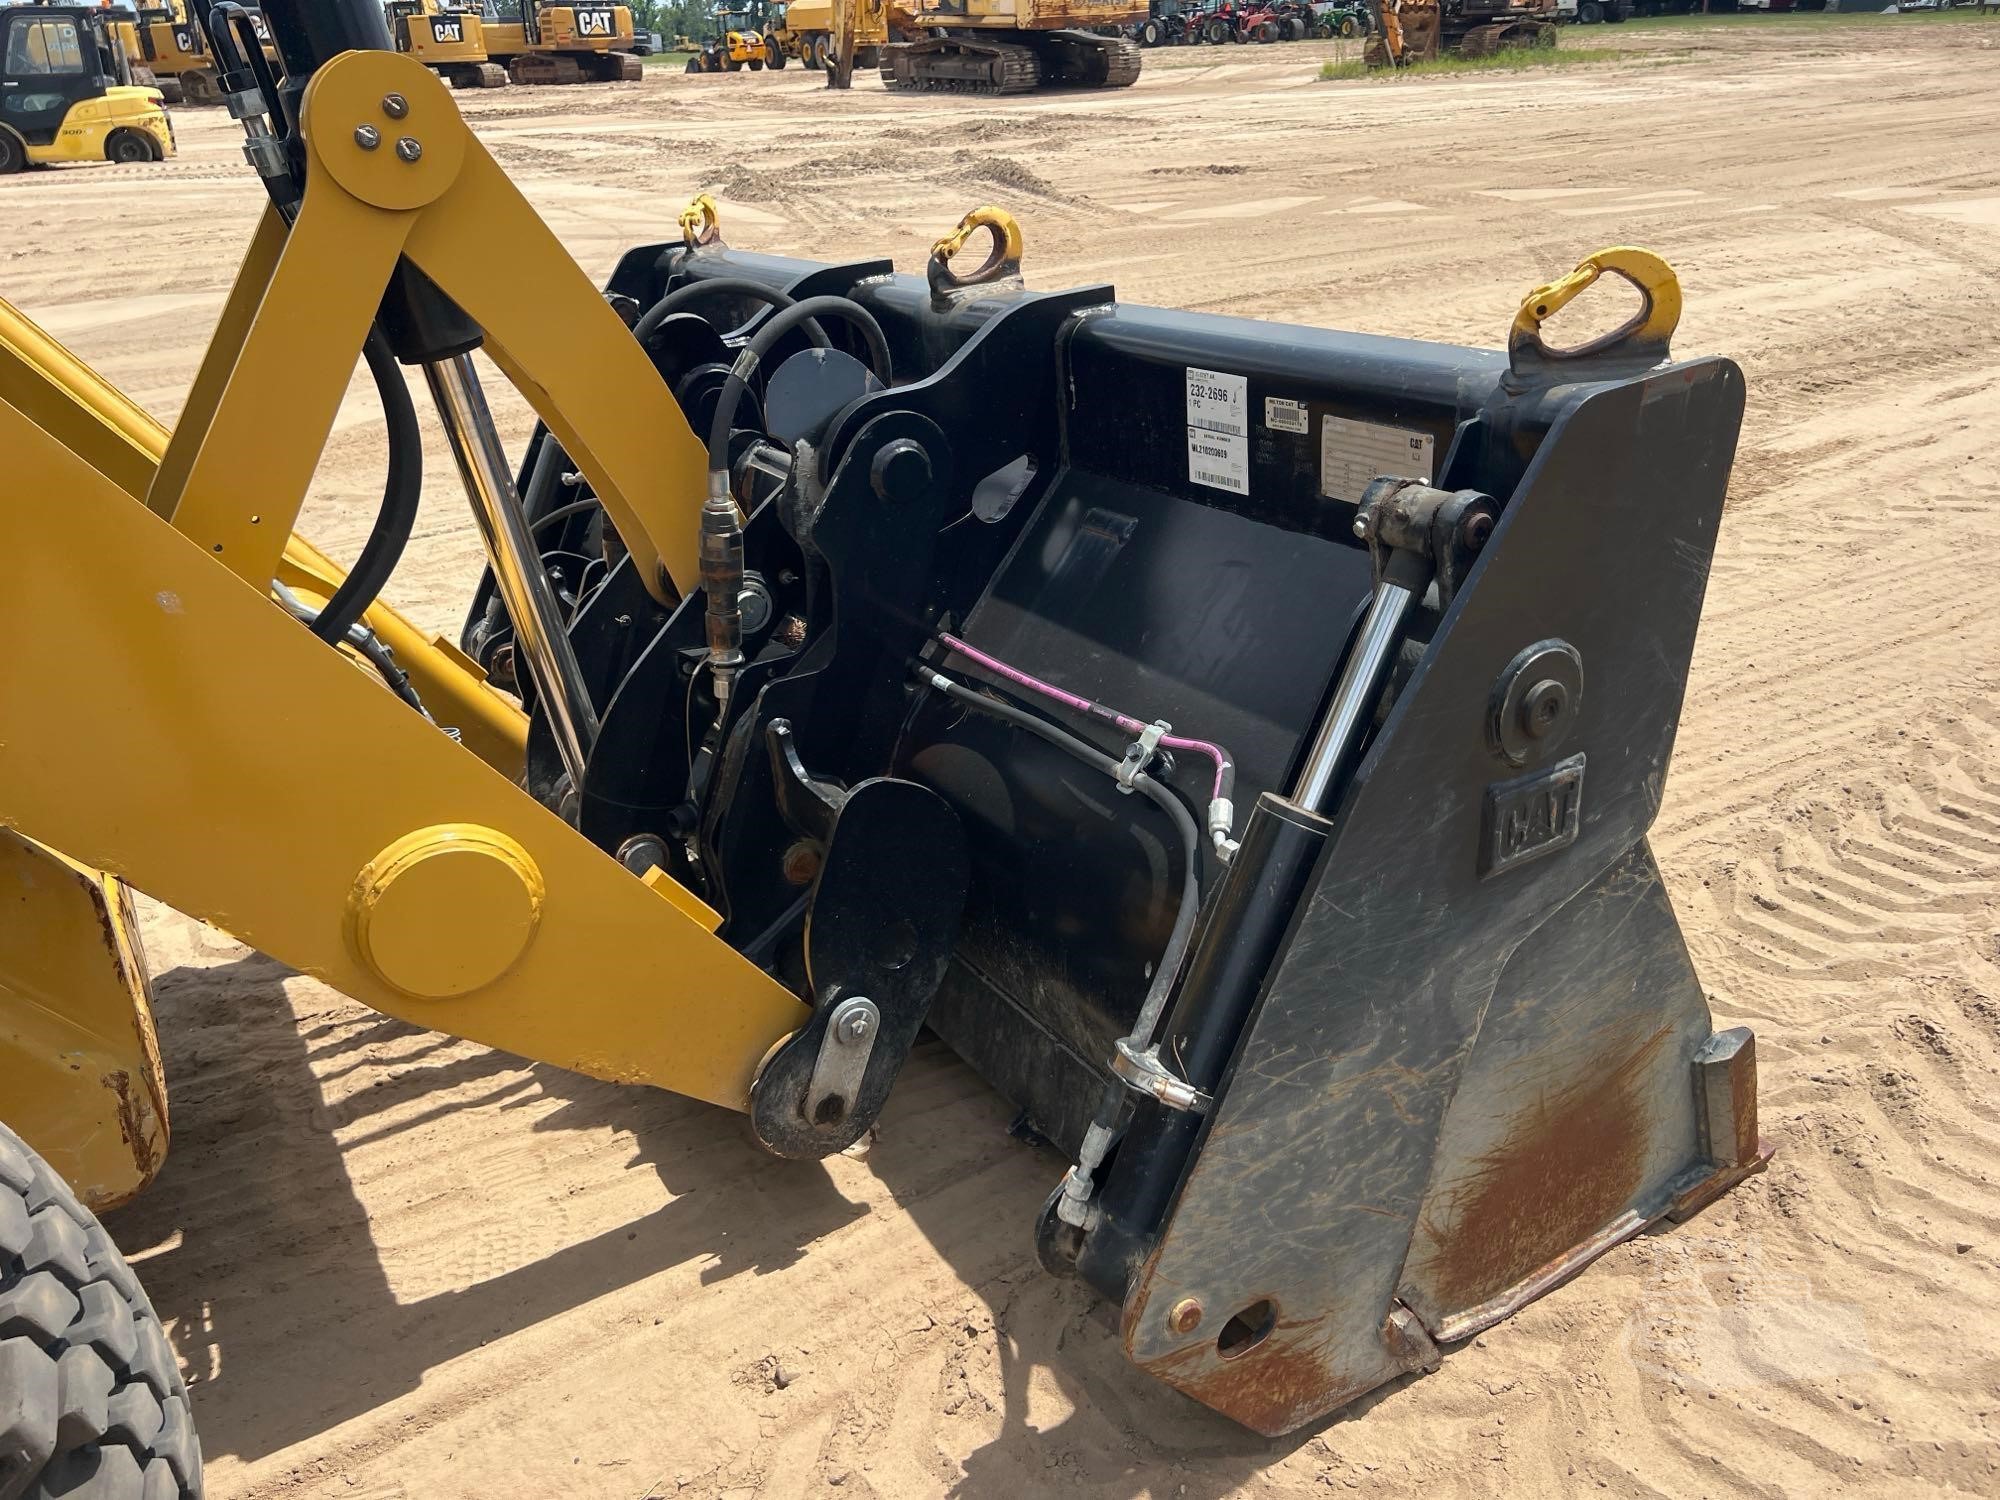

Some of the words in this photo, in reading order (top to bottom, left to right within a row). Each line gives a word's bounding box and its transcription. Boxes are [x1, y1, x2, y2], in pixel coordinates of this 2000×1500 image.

[434, 23, 460, 43] CAT
[578, 11, 612, 37] CAT
[1190, 383, 1228, 402] 232-2696
[1410, 437, 1423, 449] CAT
